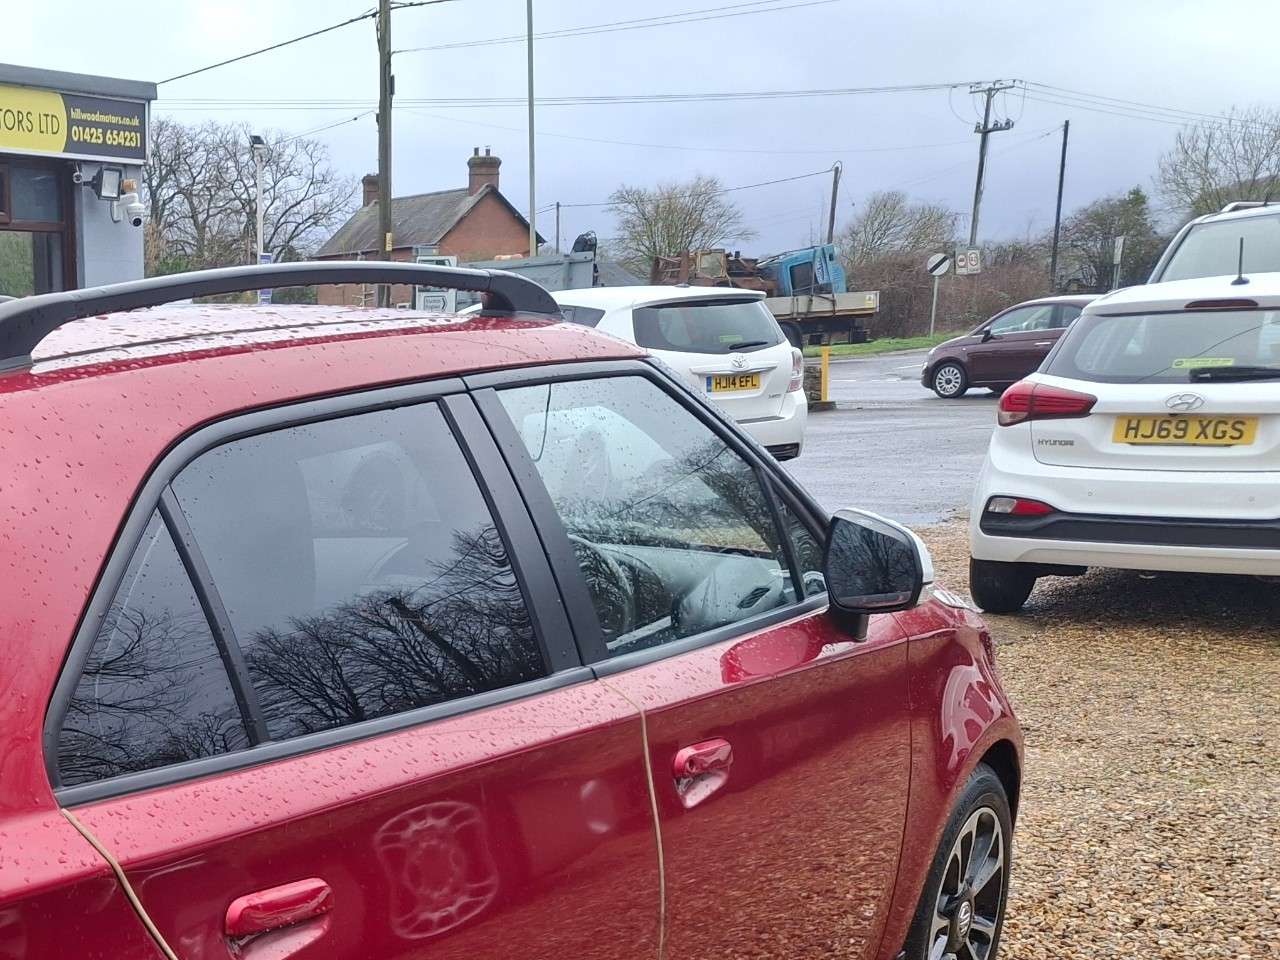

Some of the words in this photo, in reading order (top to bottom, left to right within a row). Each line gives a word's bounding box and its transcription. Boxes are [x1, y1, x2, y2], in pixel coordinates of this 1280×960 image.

[39, 114, 60, 135] LTD
[70, 107, 140, 126] hillwoodmotors.co.uk
[71, 125, 104, 144] 01425
[105, 129, 141, 147] 654231
[714, 376, 736, 390] HJ14
[738, 374, 757, 388] EFL
[1124, 419, 1189, 440] HJ69
[1195, 419, 1246, 440] XGS
